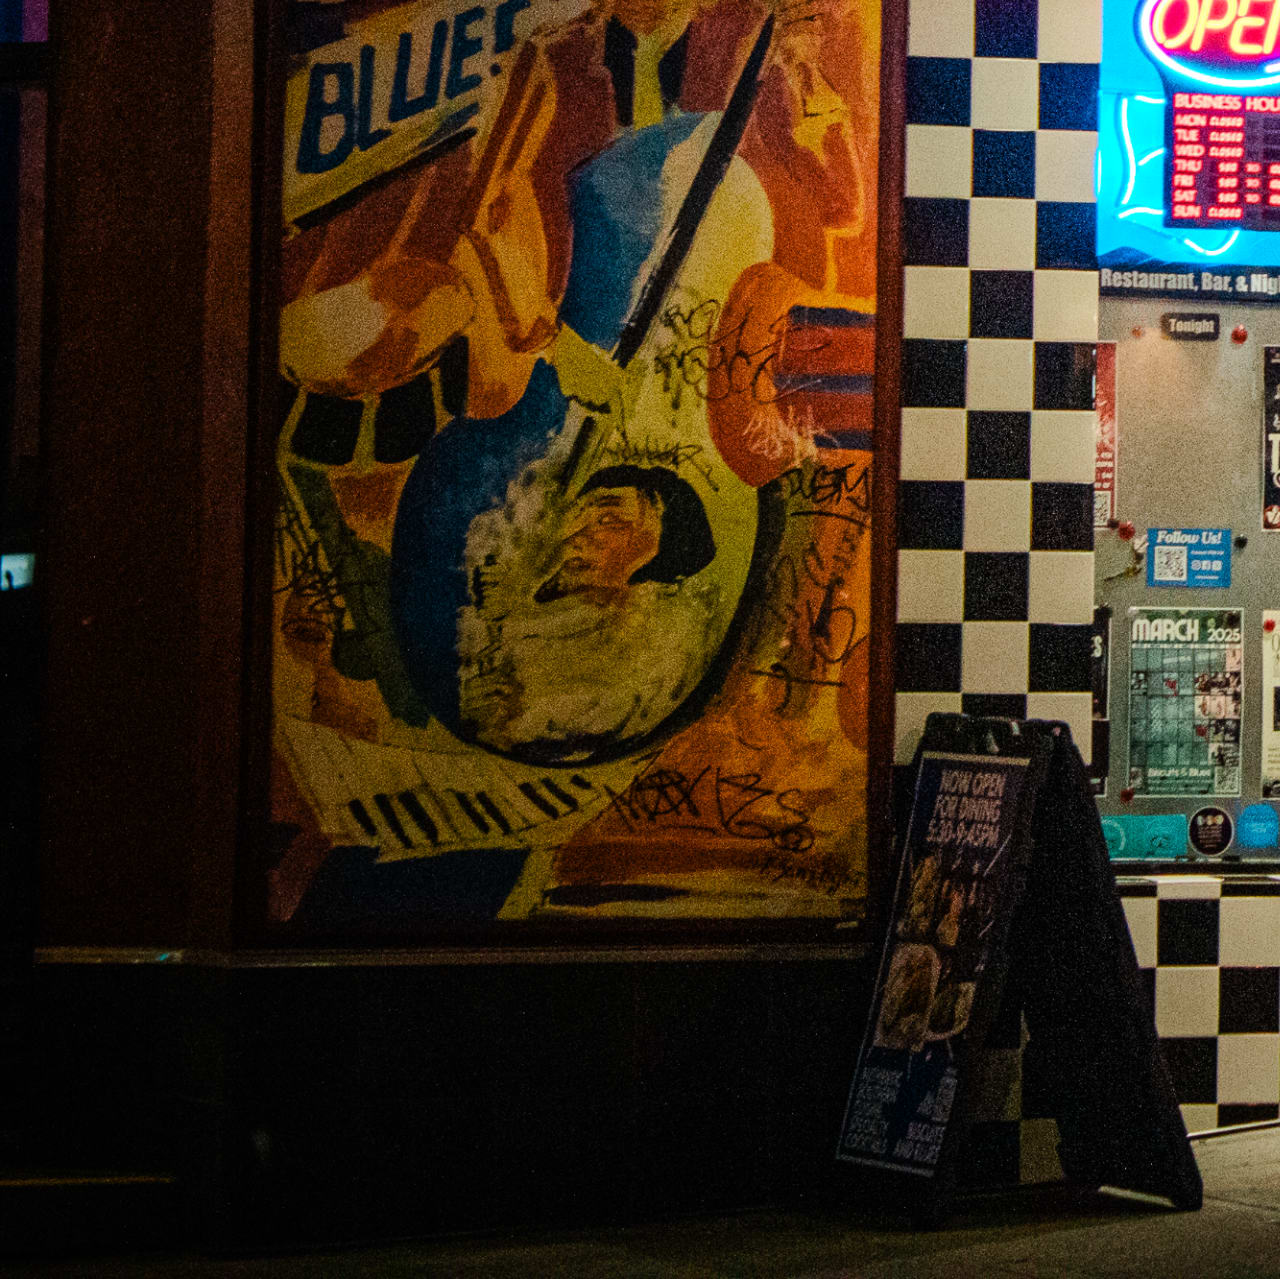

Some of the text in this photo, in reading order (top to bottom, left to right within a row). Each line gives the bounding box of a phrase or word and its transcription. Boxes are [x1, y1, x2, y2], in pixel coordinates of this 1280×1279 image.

[1174, 93, 1242, 110] BUSINESS
[1175, 129, 1199, 141] TUE
[1100, 268, 1199, 292] Restaurant,
[1236, 275, 1249, 293] &
[1169, 318, 1215, 334] Tonight
[1156, 529, 1222, 545] Follow Us!
[1132, 618, 1241, 642] MARCH 2025
[939, 770, 1007, 798] NOW OPEN
